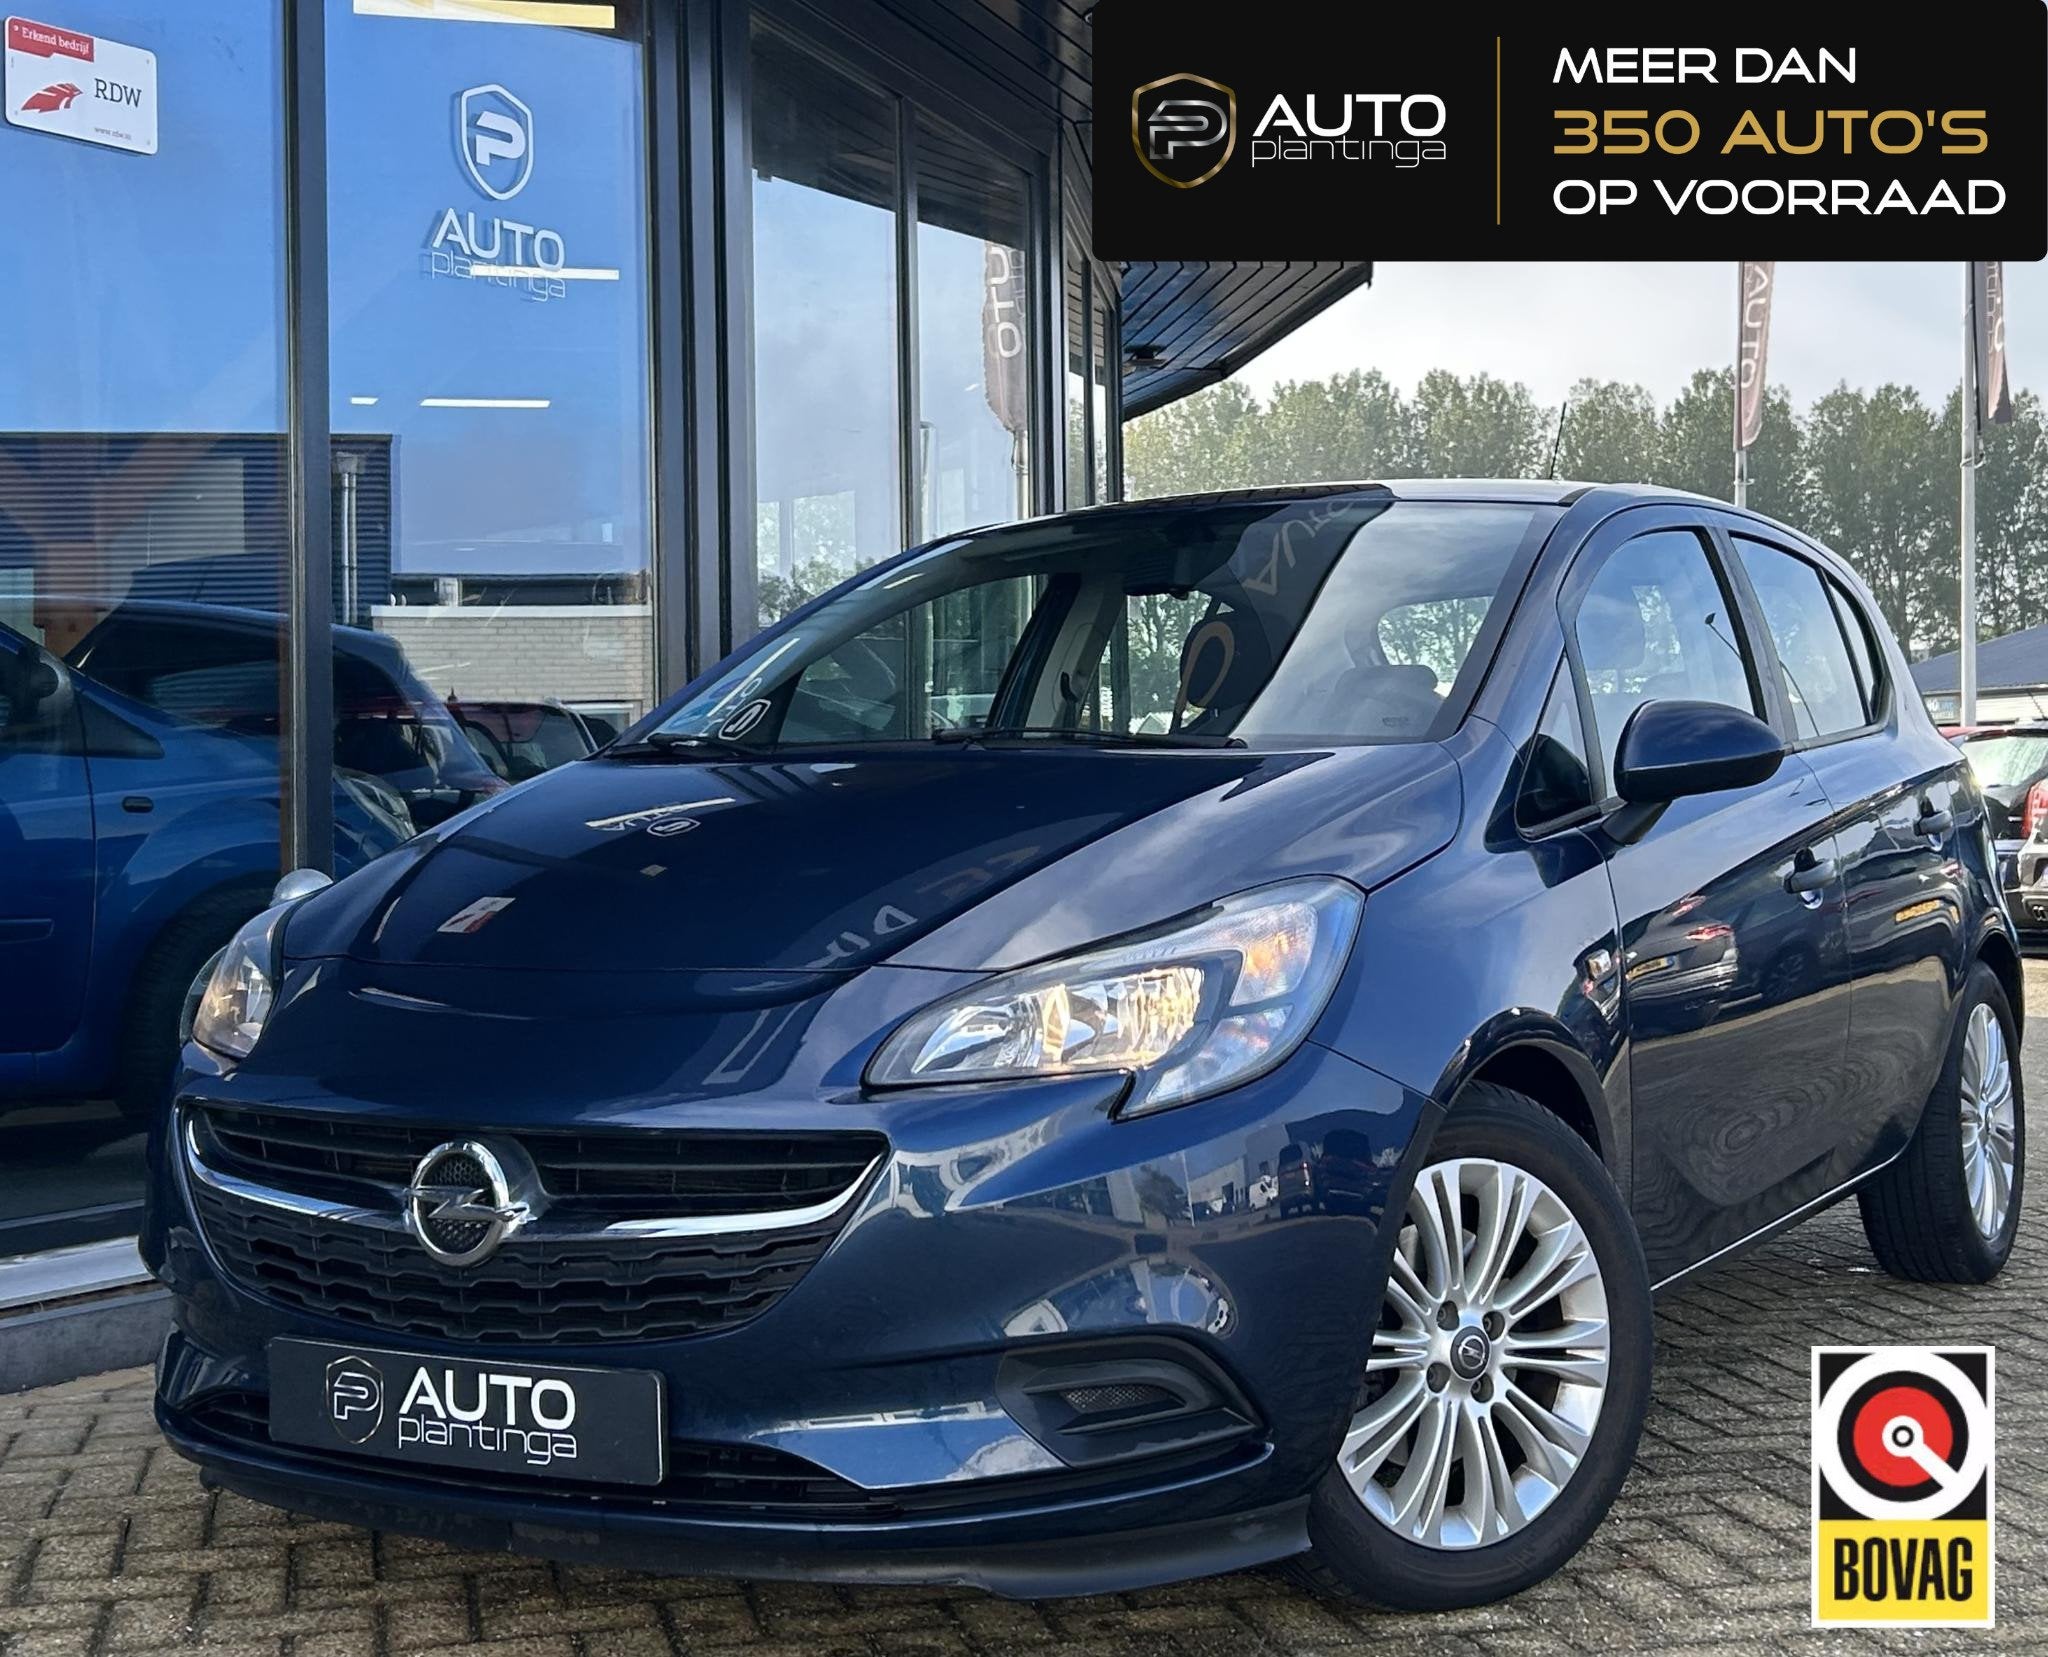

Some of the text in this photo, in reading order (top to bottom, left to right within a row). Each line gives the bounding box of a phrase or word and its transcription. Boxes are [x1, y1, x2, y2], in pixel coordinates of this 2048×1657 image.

[21, 26, 57, 46] Erkend
[94, 77, 142, 108] RDW
[432, 207, 566, 272] AUTO
[1740, 265, 1769, 389] AUTO
[399, 1366, 577, 1431] AUTO
[398, 1413, 578, 1466] plantinga
